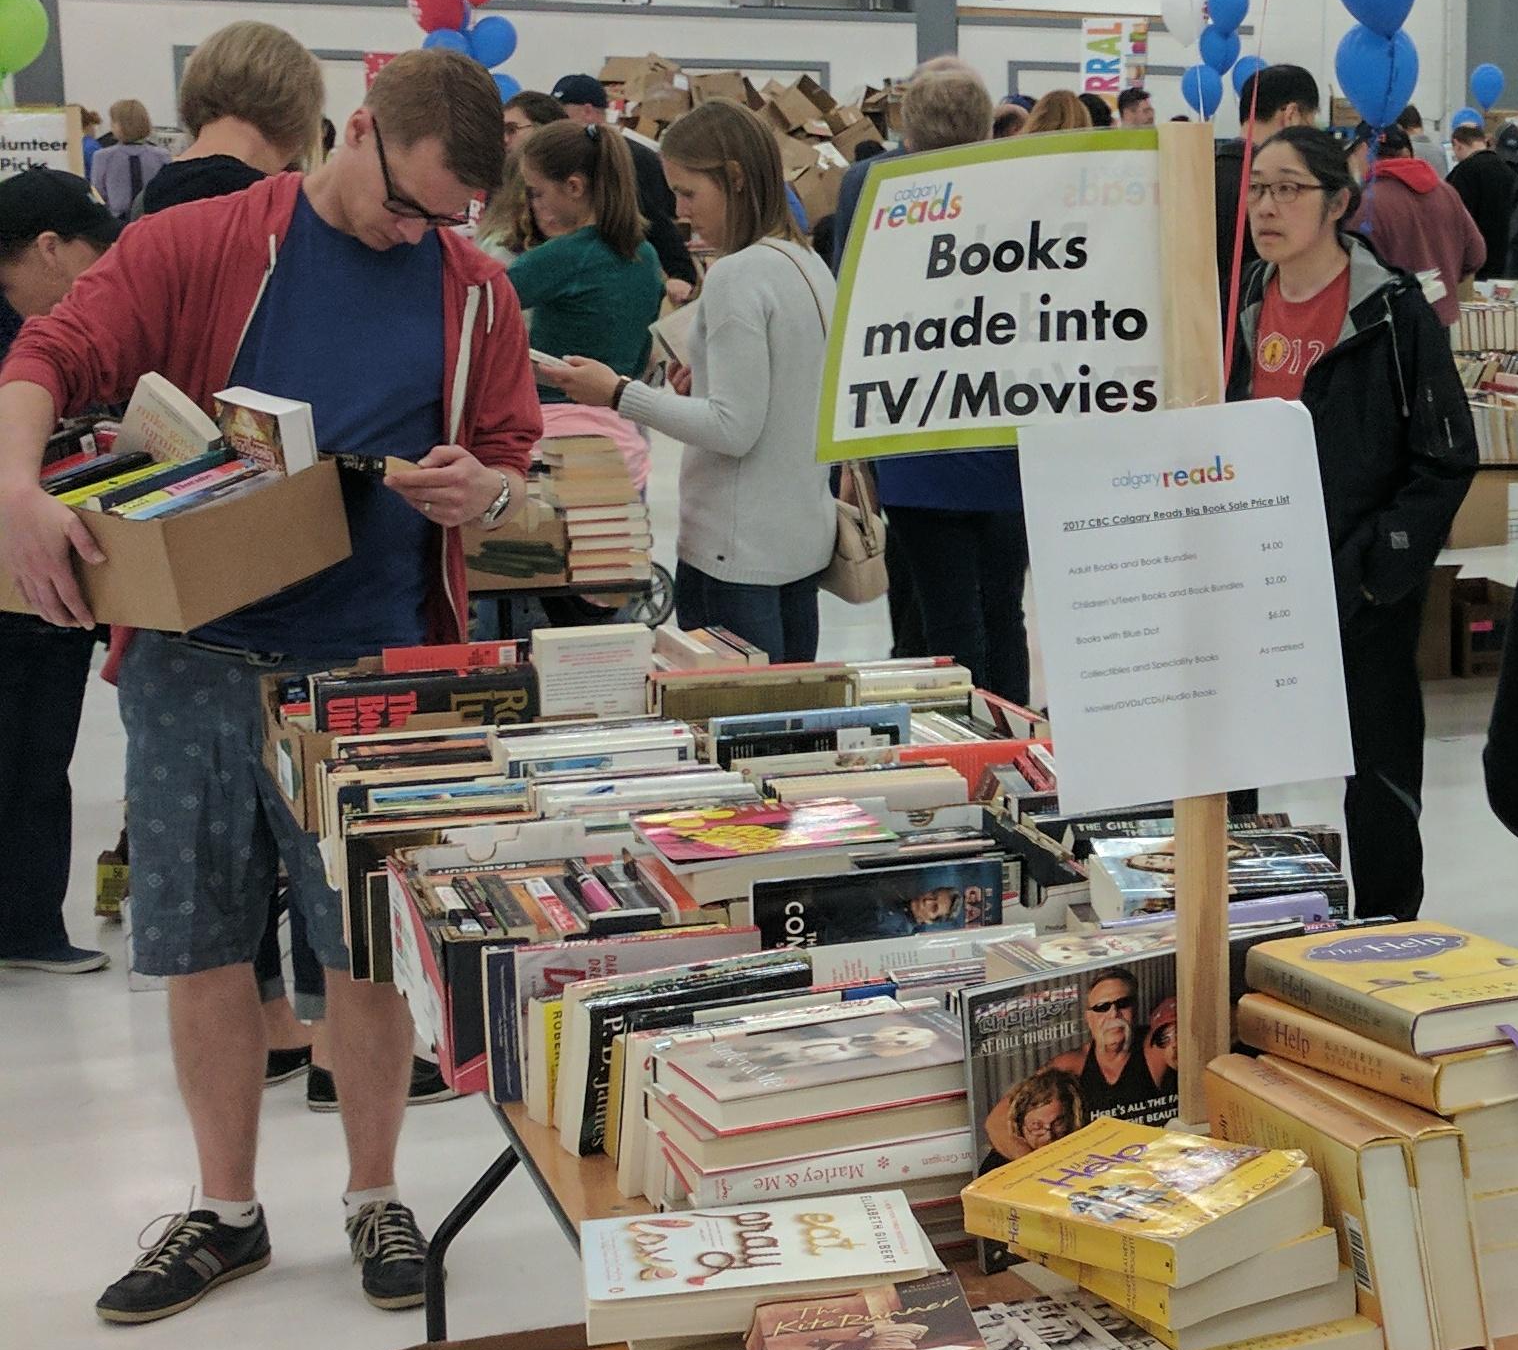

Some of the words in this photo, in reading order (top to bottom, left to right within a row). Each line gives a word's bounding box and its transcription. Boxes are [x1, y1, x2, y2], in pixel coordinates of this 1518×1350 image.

[873, 182, 963, 231] reads
[894, 181, 942, 202] calgary
[926, 220, 1088, 280] Books
[863, 296, 1016, 358] made
[1039, 293, 1148, 342] into
[849, 364, 1158, 429] TV/Movies
[1111, 469, 1161, 490] calgary
[1163, 455, 1236, 488] reads
[1063, 519, 1086, 532] 2017
[1112, 512, 1151, 526] Calgary
[1153, 508, 1183, 521] Reads
[1185, 506, 1200, 518] Big
[1202, 502, 1227, 514] Book
[1228, 499, 1249, 510] Sale
[1250, 496, 1274, 508] Price
[1276, 494, 1290, 505] List
[1094, 562, 1118, 573] Books
[1120, 559, 1139, 569] and
[1140, 556, 1163, 567] Book
[1164, 552, 1198, 564] Bundles
[1261, 540, 1284, 552] $4.00
[1142, 590, 1167, 602] Books
[1169, 588, 1187, 598] and
[1188, 585, 1210, 596] Book
[1211, 581, 1244, 593] Bundles
[1264, 574, 1288, 586] $2.00
[1076, 634, 1102, 645] Books
[1122, 628, 1142, 639] Blue
[1143, 626, 1160, 637] Dot
[1132, 662, 1151, 673] and
[1195, 653, 1220, 665] Books
[1275, 676, 1298, 688] $2.00
[1106, 819, 1137, 832] GIRL
[1327, 945, 1363, 957] The
[1365, 933, 1448, 955] Help
[975, 984, 1080, 1024] AMERICAN
[1281, 970, 1312, 1007] Help
[1274, 1020, 1311, 1060] Help
[1127, 1100, 1146, 1114] ALL
[1148, 1096, 1167, 1110] THE
[752, 1174, 780, 1192] Me
[782, 1174, 799, 1188] &
[802, 1162, 865, 1185] Marley
[1037, 1142, 1149, 1189] Help
[795, 1211, 867, 1257] eat
[859, 1194, 884, 1230] ELIZABETH
[873, 1230, 897, 1265] GILBERT
[1006, 1206, 1021, 1245] Help
[624, 1218, 694, 1282] love
[686, 1211, 783, 1286] pray
[773, 1316, 838, 1338] Kite
[838, 1295, 960, 1329] Runner
[798, 1306, 844, 1320] The
[989, 1300, 1081, 1321] BEFORE
